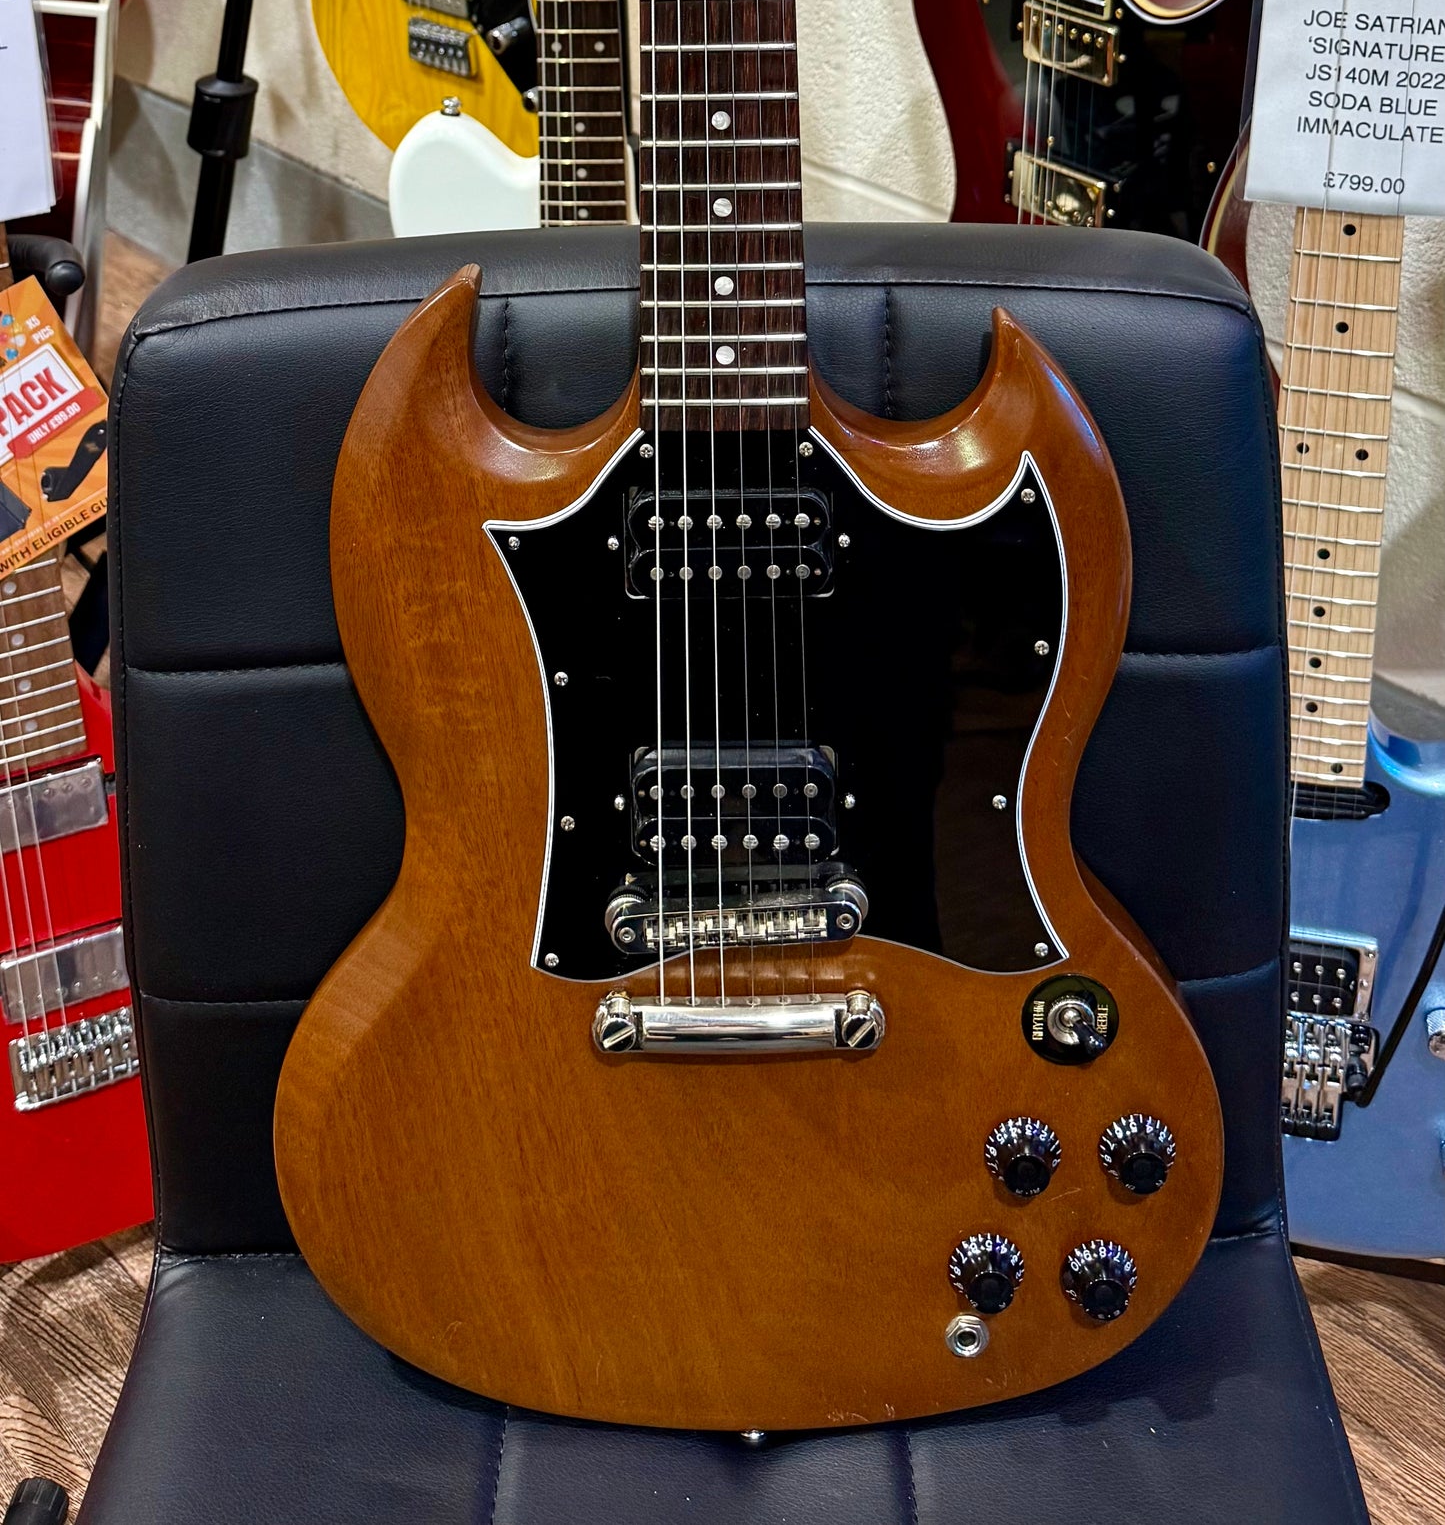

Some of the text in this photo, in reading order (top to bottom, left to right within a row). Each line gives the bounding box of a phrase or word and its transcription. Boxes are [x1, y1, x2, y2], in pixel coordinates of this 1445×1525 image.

[1303, 10, 1348, 29] JOE
[1305, 64, 1445, 90] JS140M 2022
[1308, 91, 1438, 117] SODA BLUE
[1297, 115, 1444, 144] IMMACULATE
[1323, 171, 1405, 195] £799.00
[31, 324, 55, 345] PICS
[26, 422, 50, 445] ONLY
[32, 509, 91, 551] ELIGIBLE
[1031, 1000, 1046, 1041] RHYTHM
[1096, 1003, 1109, 1034] REBLE
